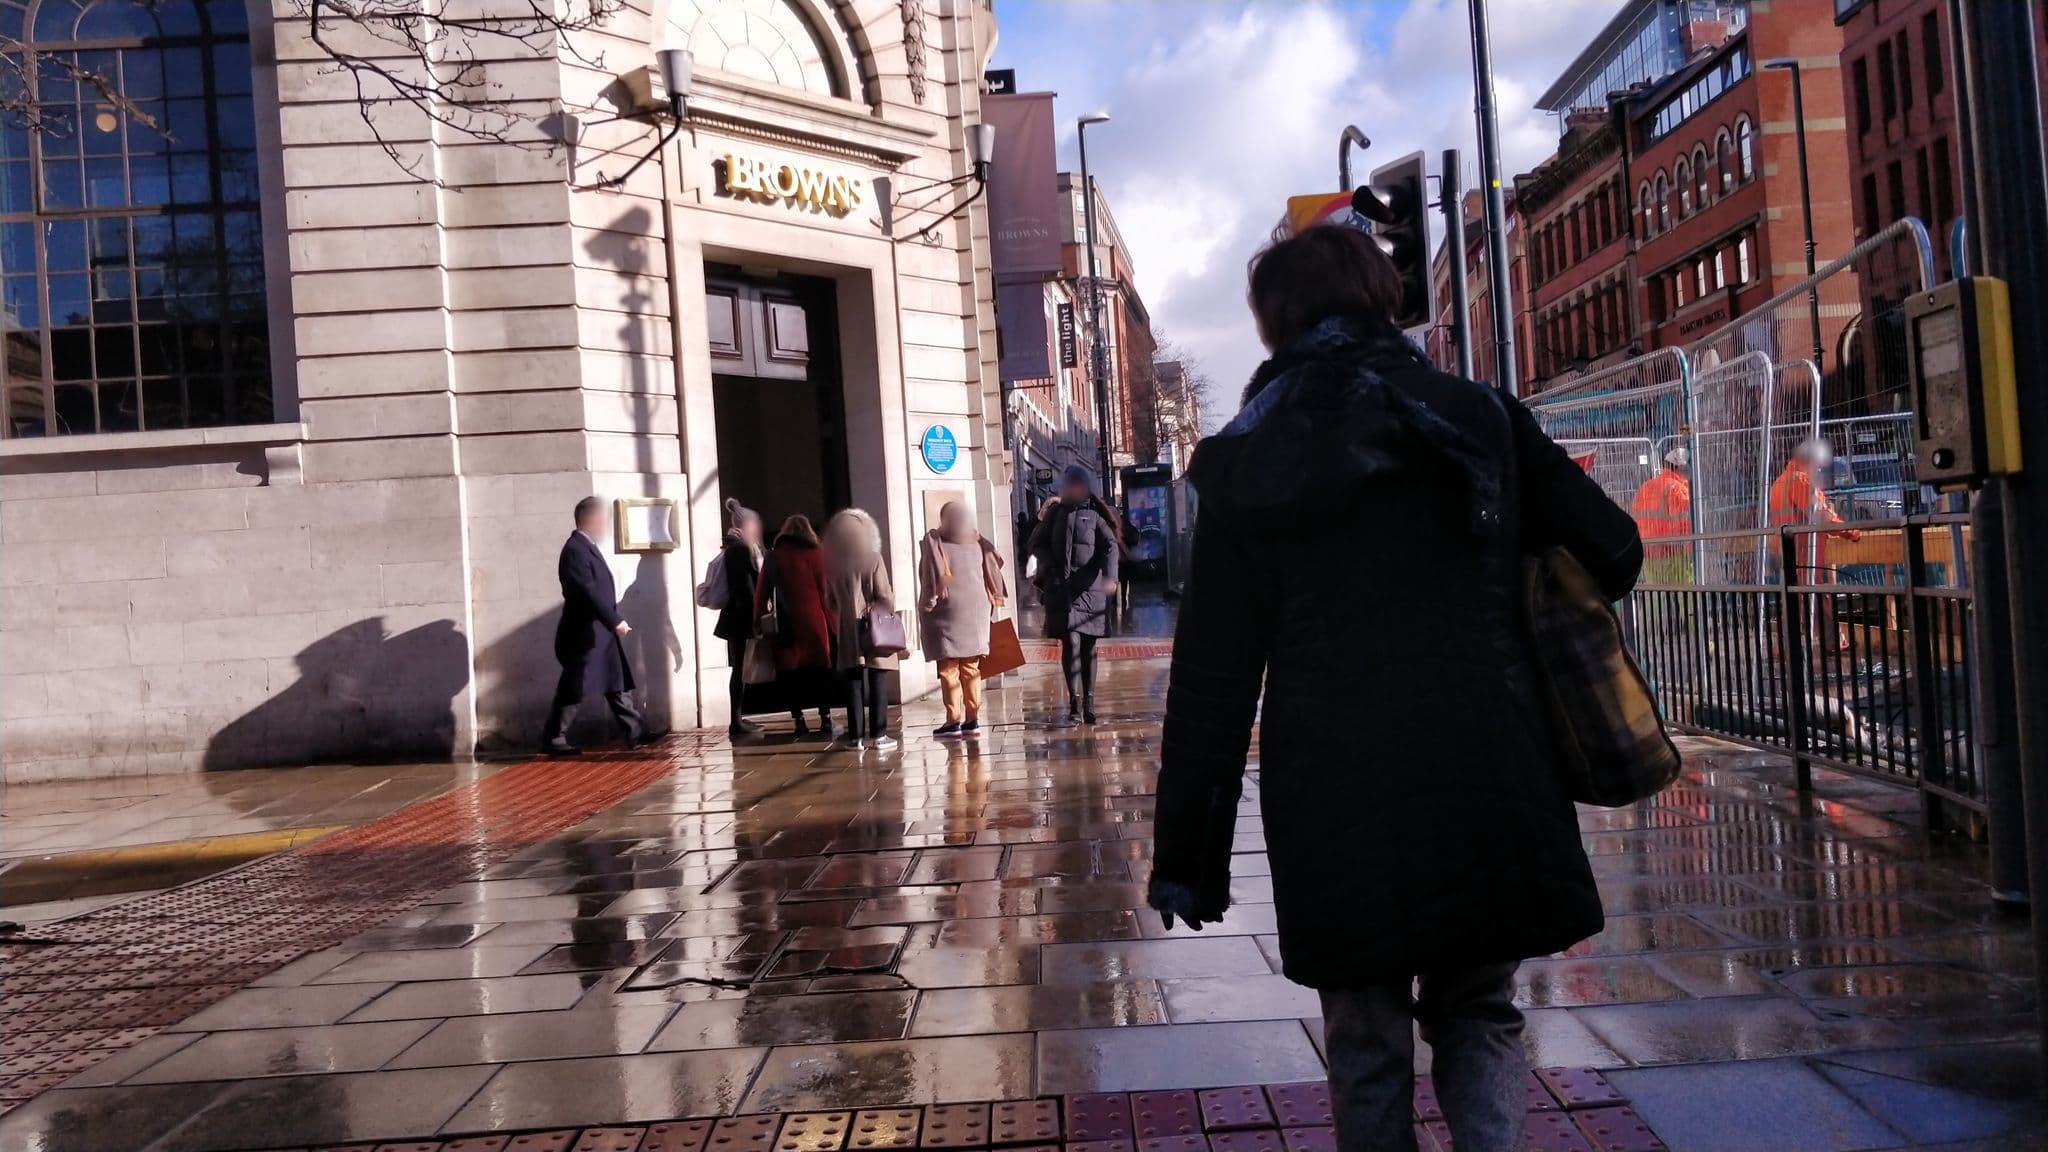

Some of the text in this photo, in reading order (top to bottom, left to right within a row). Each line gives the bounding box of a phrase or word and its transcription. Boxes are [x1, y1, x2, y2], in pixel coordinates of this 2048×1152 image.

[724, 153, 862, 210] BROWNS
[997, 227, 1049, 241] BROWNS
[1061, 307, 1073, 363] the light
